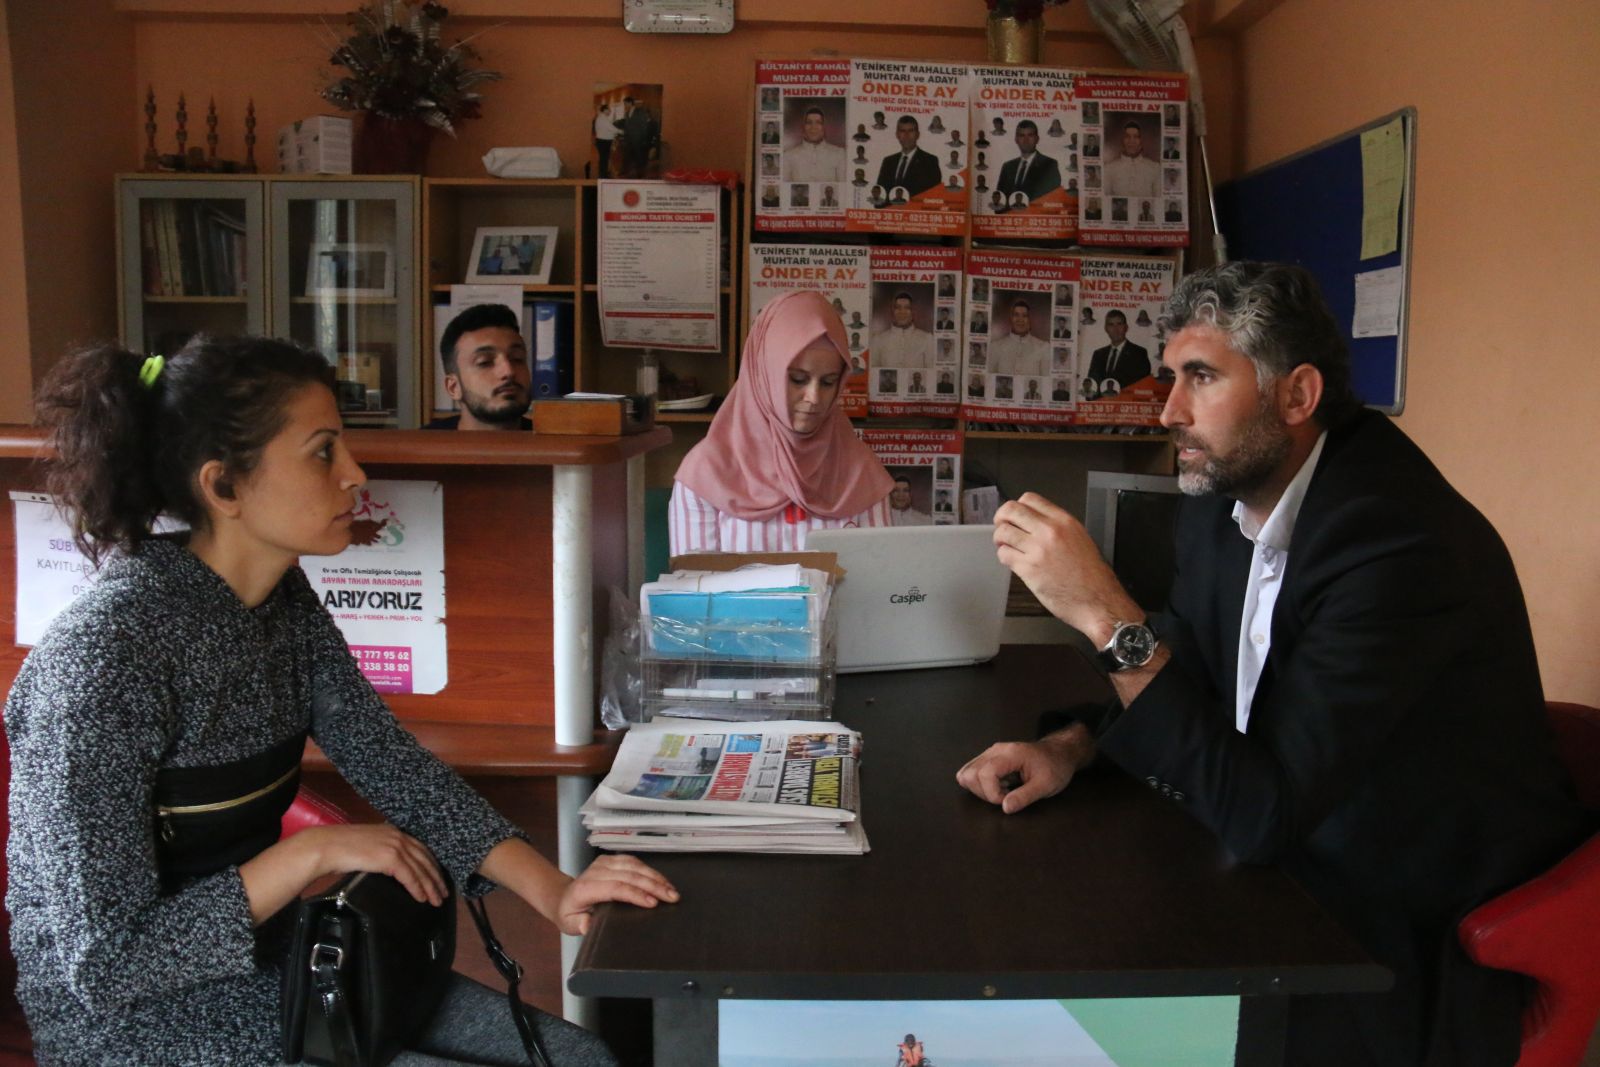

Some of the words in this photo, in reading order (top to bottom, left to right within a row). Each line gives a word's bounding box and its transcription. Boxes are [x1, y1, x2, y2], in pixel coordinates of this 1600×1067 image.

[855, 62, 907, 72] YENİKENT
[910, 65, 968, 75] MAHALLESİ
[973, 68, 1025, 77] YENİKENT
[772, 74, 819, 82] MUHTAR
[864, 72, 910, 81] MUHTARI
[928, 75, 958, 84] ADAYI
[983, 78, 1029, 86] MUHTARI
[862, 80, 928, 96] ÖNDER
[934, 86, 958, 98] AY
[1130, 80, 1180, 88] MAHALLESİ
[831, 87, 846, 95] AY
[980, 86, 1046, 100] ÖNDER
[1053, 90, 1075, 102] AY
[1091, 89, 1136, 97] MUHTAR
[1139, 91, 1169, 99] ADAYI
[1147, 104, 1161, 112] AY
[754, 246, 806, 255] YENİKENT
[809, 248, 868, 257] MAHALLESİ
[904, 249, 956, 257] MAHALLESİ
[763, 256, 810, 265] MUHTARI
[827, 258, 858, 266] ADAYI
[1023, 258, 1075, 268] MAHALLESİ
[1117, 261, 1172, 271] MAHALLESİ
[761, 265, 828, 279] ÖNDER
[833, 268, 858, 280] AY
[982, 266, 1028, 277] MUHTAR
[1030, 270, 1062, 278] ADAYI
[1133, 272, 1162, 280] ADAYI
[920, 273, 936, 282] AY
[1038, 283, 1053, 291] AY
[1139, 281, 1162, 294] AY
[903, 433, 956, 441] MAHALLESİ
[910, 443, 943, 452] ADAYI
[919, 457, 934, 465] AY
[323, 589, 423, 611] ARIYORUZ
[890, 593, 927, 605] Casper
[364, 650, 381, 660] 777
[383, 651, 396, 660] 95
[397, 651, 409, 660] 62
[383, 662, 396, 672] 38
